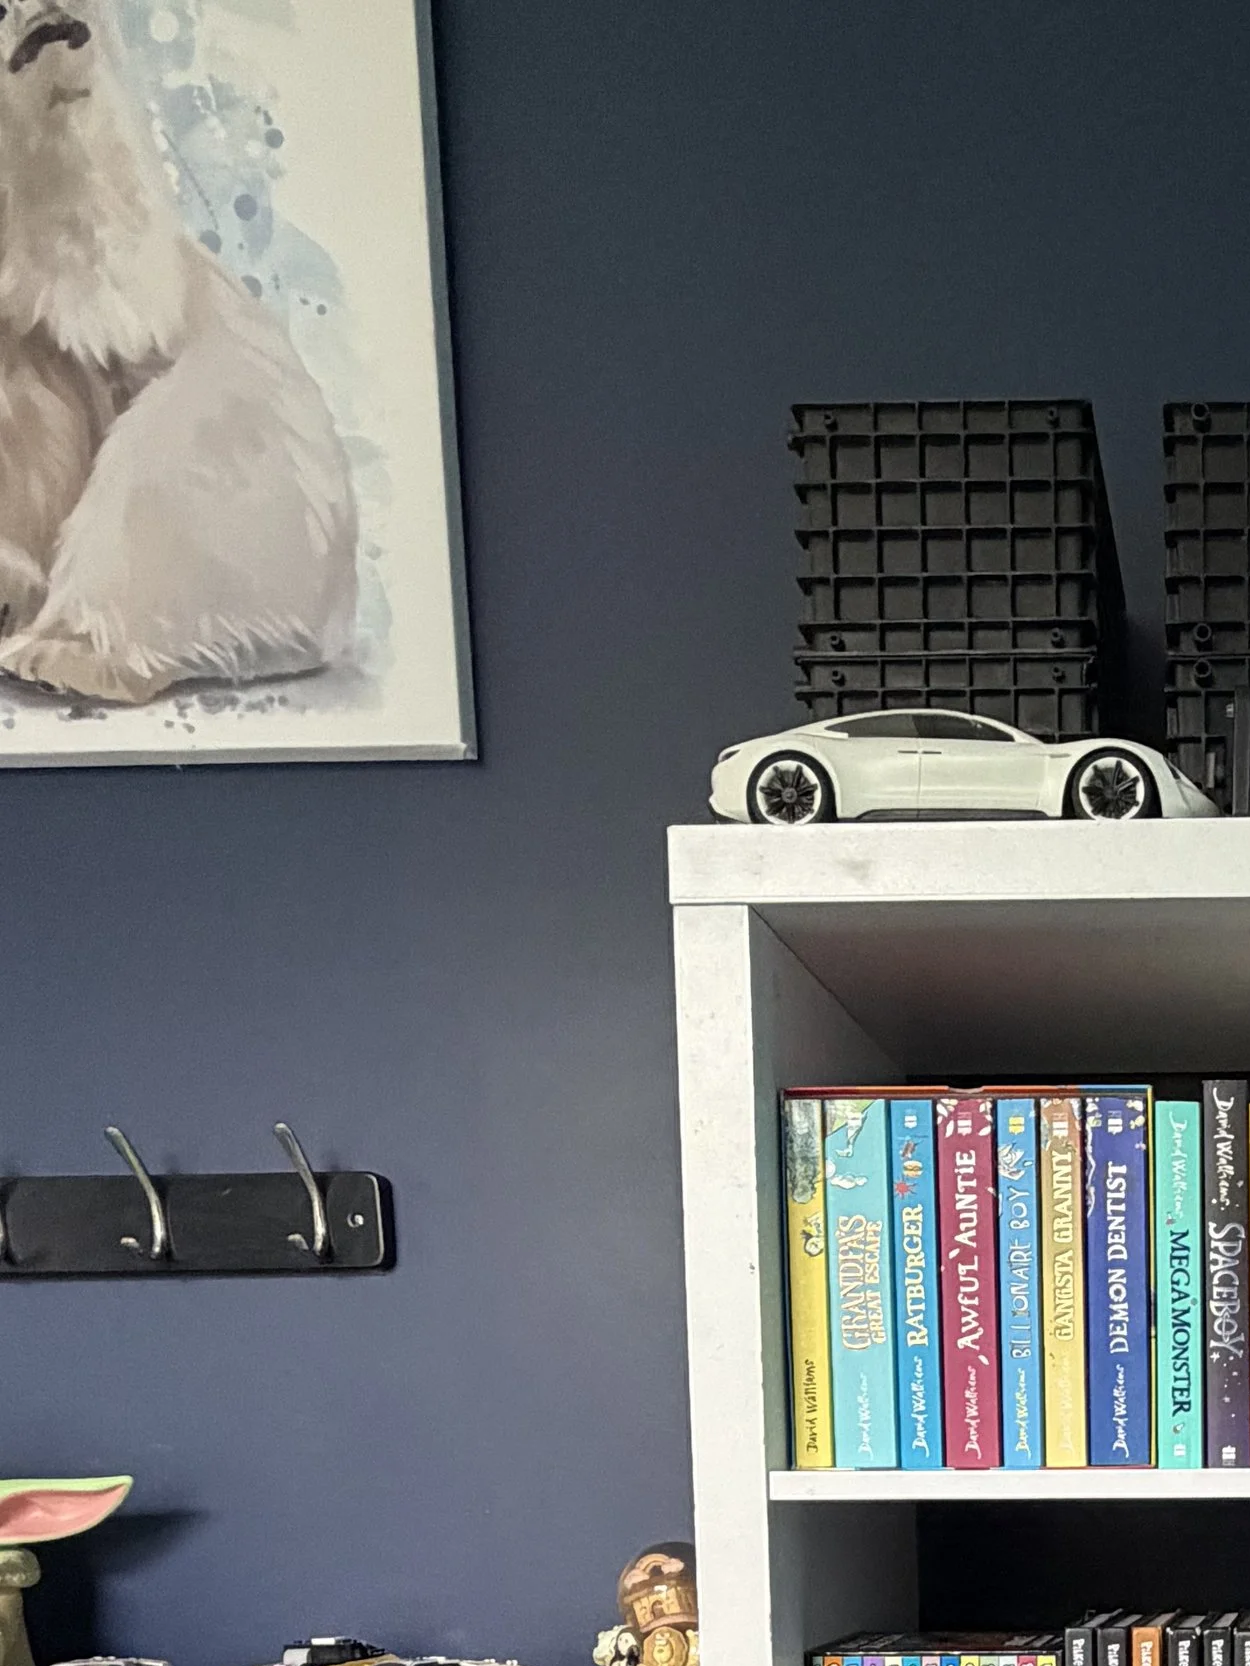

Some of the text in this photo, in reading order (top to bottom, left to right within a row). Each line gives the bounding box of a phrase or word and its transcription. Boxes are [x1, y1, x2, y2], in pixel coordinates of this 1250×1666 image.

[901, 1203, 929, 1347] RATBURGER
[1008, 1185, 1028, 1229] BOY
[1052, 1148, 1074, 1341] GANGSTA GRANNY
[1106, 1161, 1130, 1353] DEMON DENTIST
[865, 1220, 886, 1344] GREAT ESCAPE
[1208, 1222, 1246, 1358] SPACEBOY
